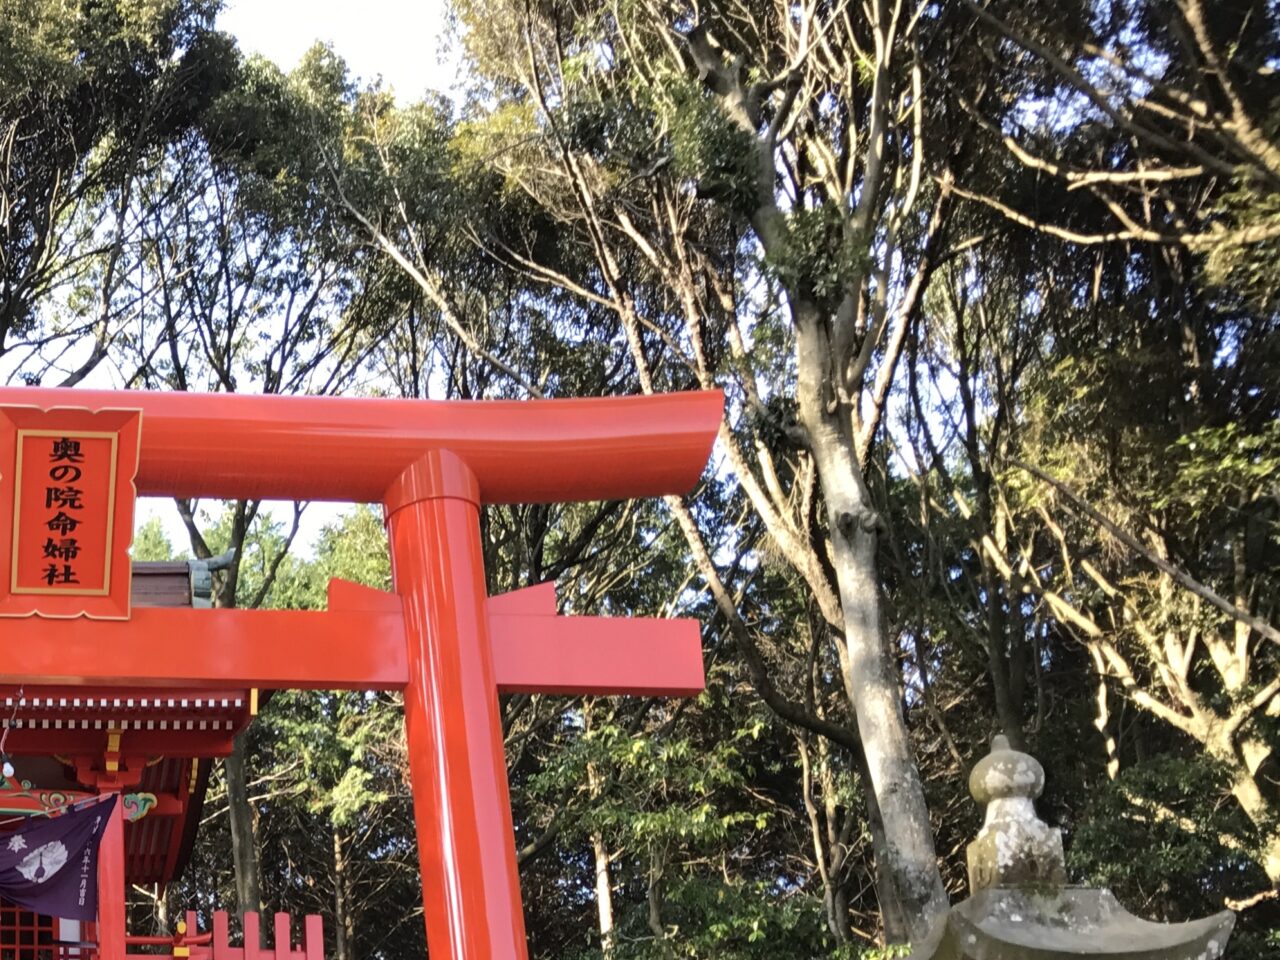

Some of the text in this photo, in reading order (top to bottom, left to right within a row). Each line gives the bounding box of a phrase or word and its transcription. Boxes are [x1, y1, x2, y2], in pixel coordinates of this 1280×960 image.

[41, 437, 85, 586] 奥の院命婦社
